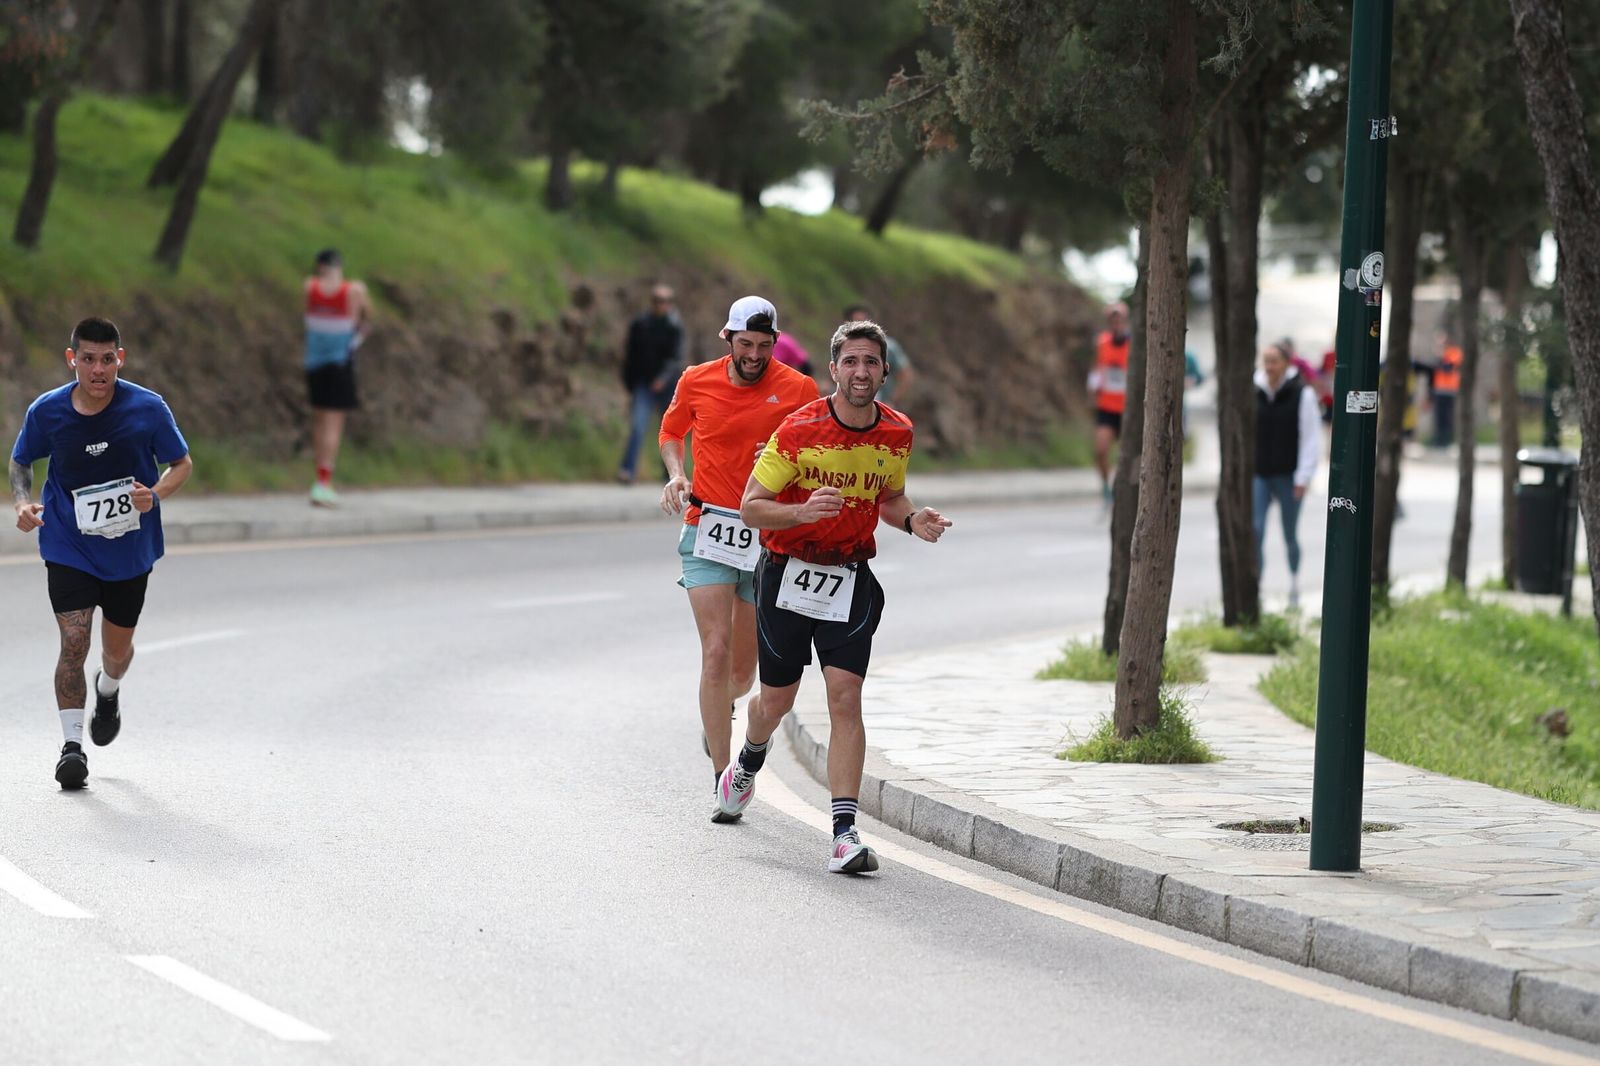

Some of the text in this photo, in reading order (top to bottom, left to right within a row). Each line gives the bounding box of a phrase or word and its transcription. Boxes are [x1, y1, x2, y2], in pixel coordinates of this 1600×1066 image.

[87, 493, 132, 522] 728
[707, 522, 753, 549] 419
[793, 568, 844, 598] 477
